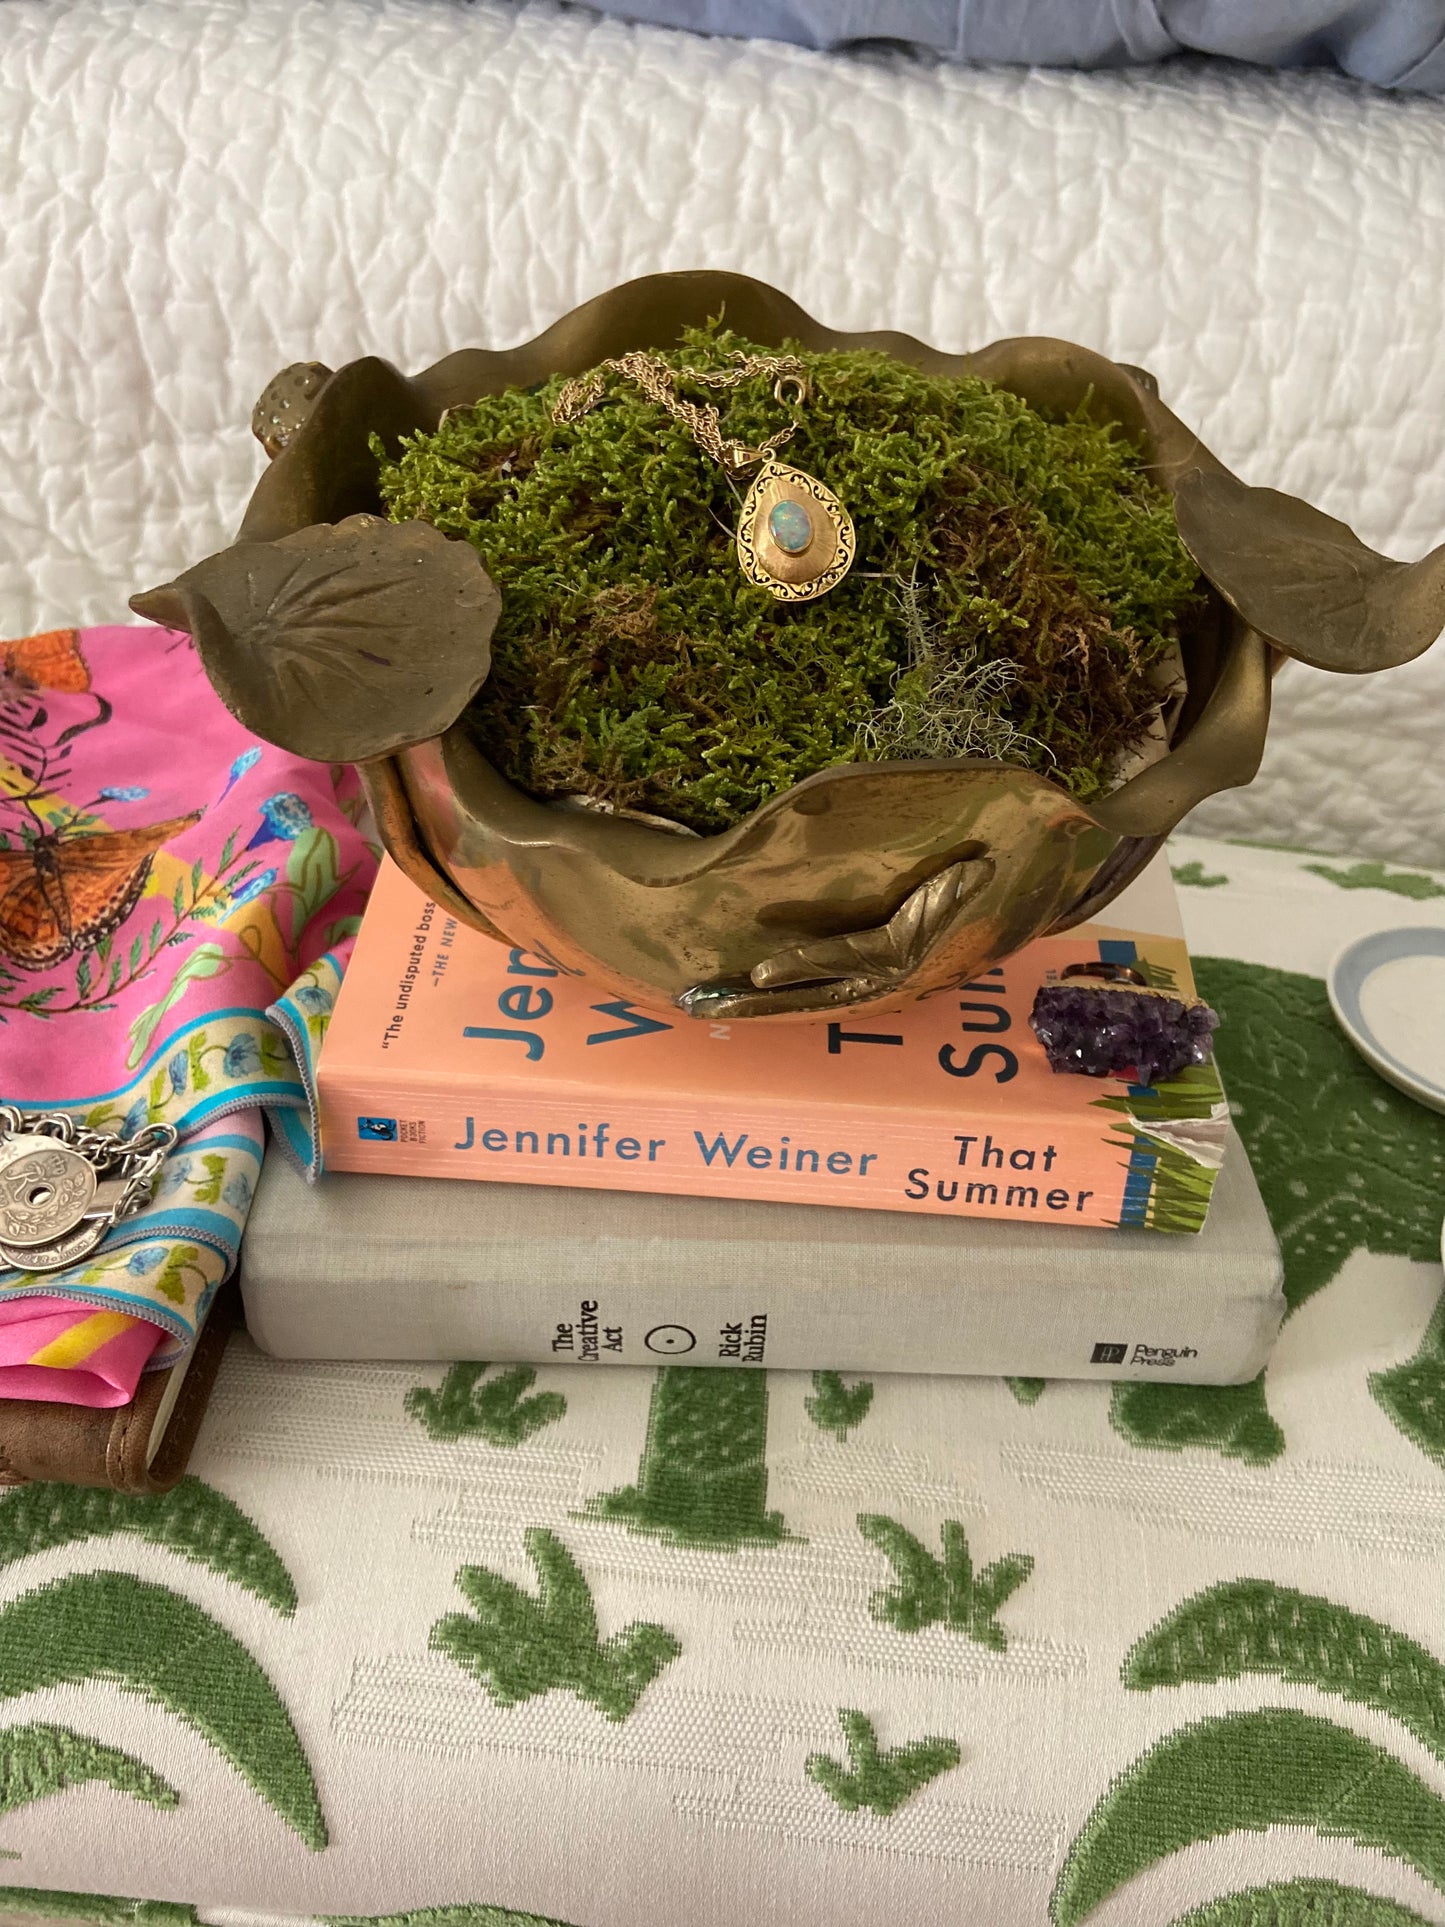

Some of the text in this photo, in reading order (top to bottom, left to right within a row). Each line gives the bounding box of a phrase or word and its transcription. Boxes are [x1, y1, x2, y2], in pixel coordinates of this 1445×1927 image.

[440, 918, 458, 947] NEW
[396, 935, 427, 1010] undisputed
[416, 901, 436, 931] boss
[454, 1116, 878, 1176] Jennifer Weiner
[953, 1135, 1058, 1173] That
[904, 1166, 1094, 1212] Summer
[552, 1323, 574, 1352] The
[575, 1300, 599, 1362] Creative
[601, 1326, 623, 1353] Act
[718, 1322, 743, 1358] Rick
[742, 1313, 768, 1363] Rubin
[1130, 1356, 1177, 1367] Press
[1134, 1344, 1198, 1359] Penguin
